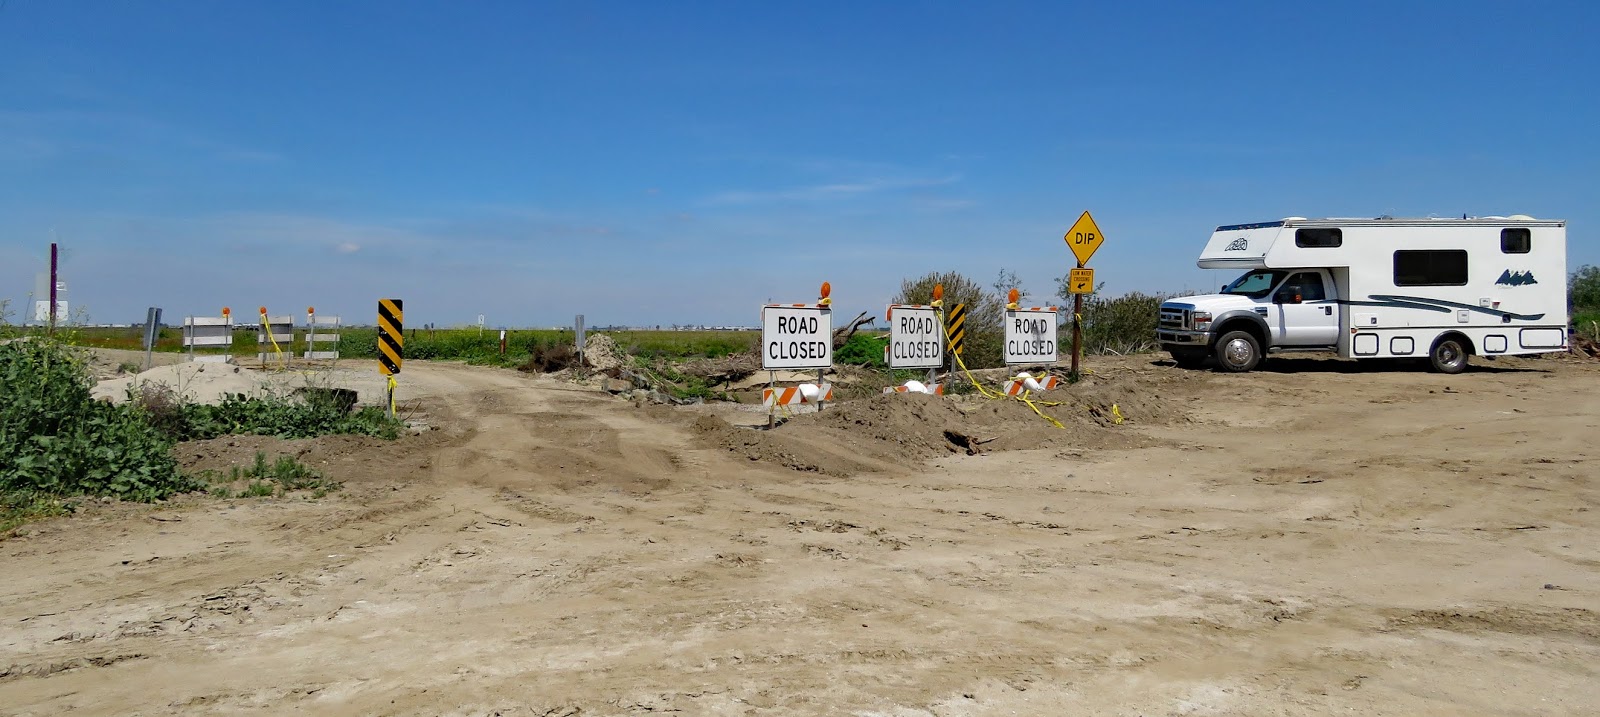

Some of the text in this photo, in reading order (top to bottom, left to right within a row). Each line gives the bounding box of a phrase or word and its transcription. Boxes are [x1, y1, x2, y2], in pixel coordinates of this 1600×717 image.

[1076, 232, 1095, 244] DIP
[778, 316, 818, 334] ROAD
[901, 317, 933, 334] ROAD
[1015, 318, 1047, 333] ROAD
[769, 341, 826, 360] CLOSED
[894, 341, 939, 358] CLOSED
[1009, 340, 1053, 355] CLOSED
